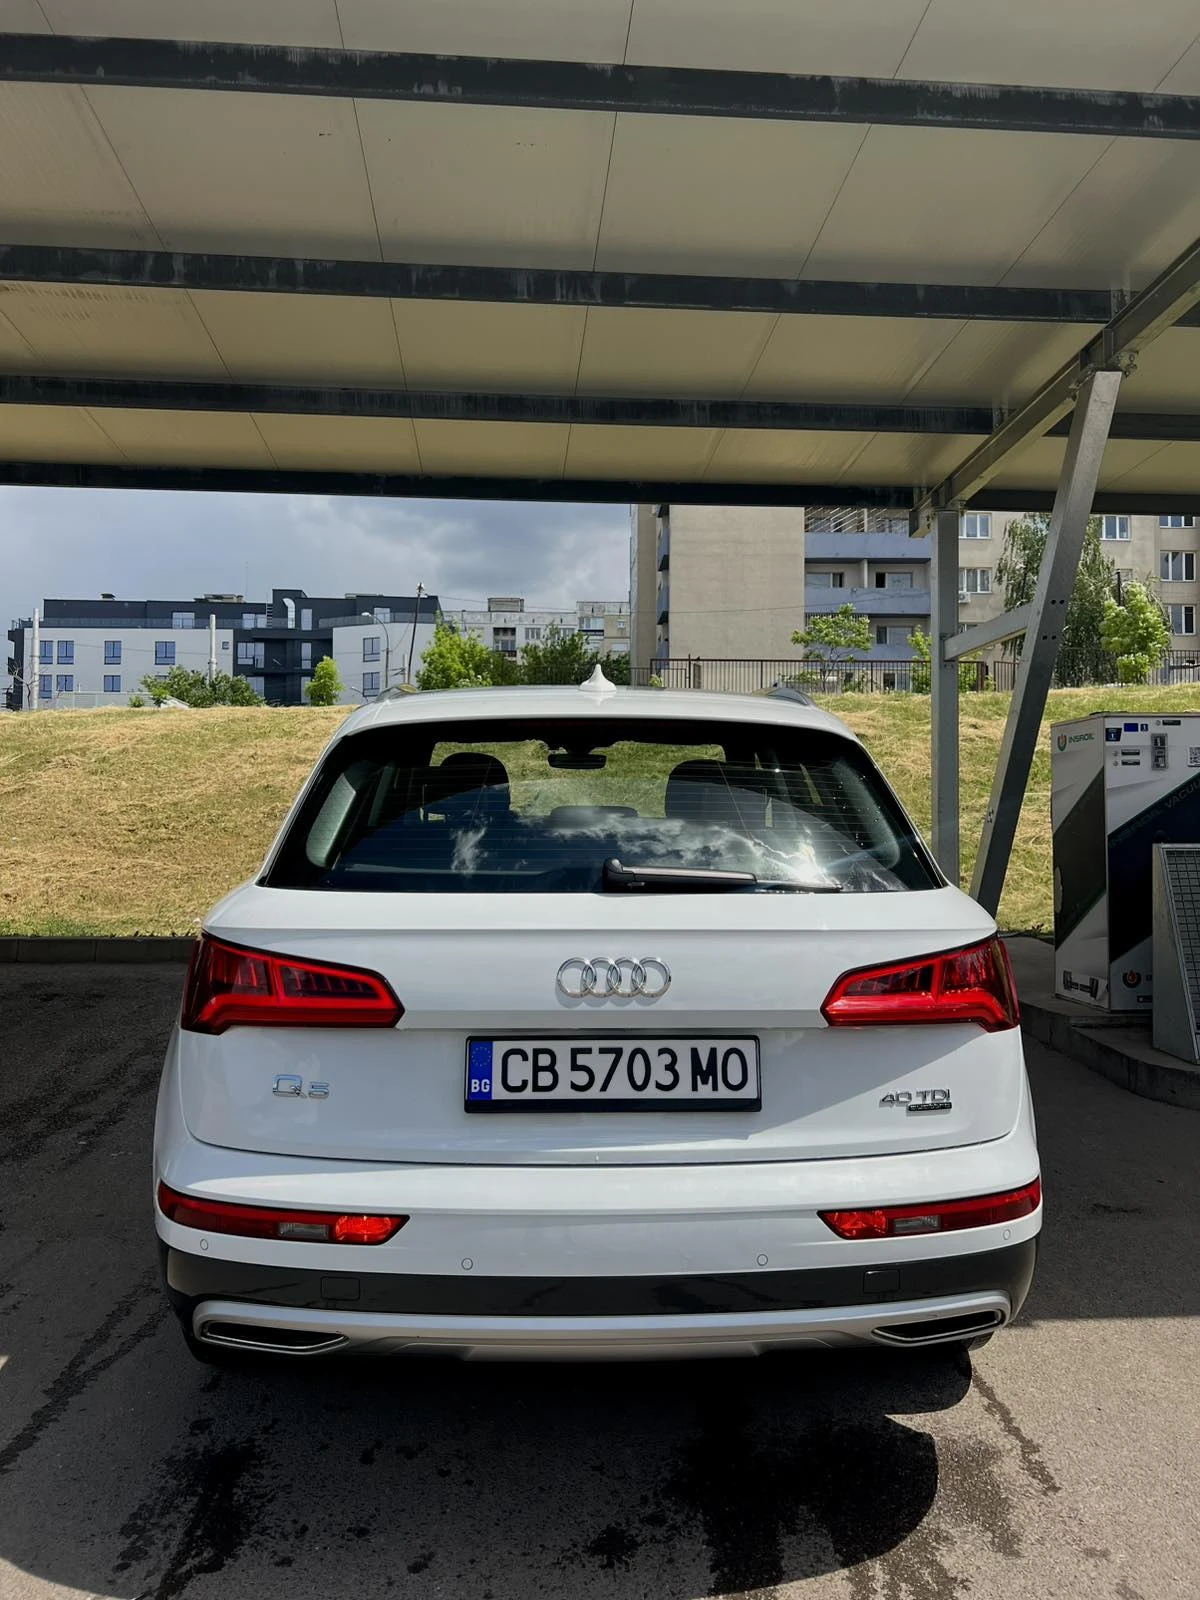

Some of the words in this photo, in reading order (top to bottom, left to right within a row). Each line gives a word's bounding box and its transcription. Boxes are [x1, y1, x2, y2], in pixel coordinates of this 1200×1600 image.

[501, 1047, 559, 1093] CB
[570, 1047, 680, 1093] 5703
[690, 1047, 749, 1093] MO
[272, 1074, 329, 1099] Q5
[471, 1079, 490, 1093] BG
[880, 1091, 912, 1103] 40
[915, 1088, 950, 1103] TDI
